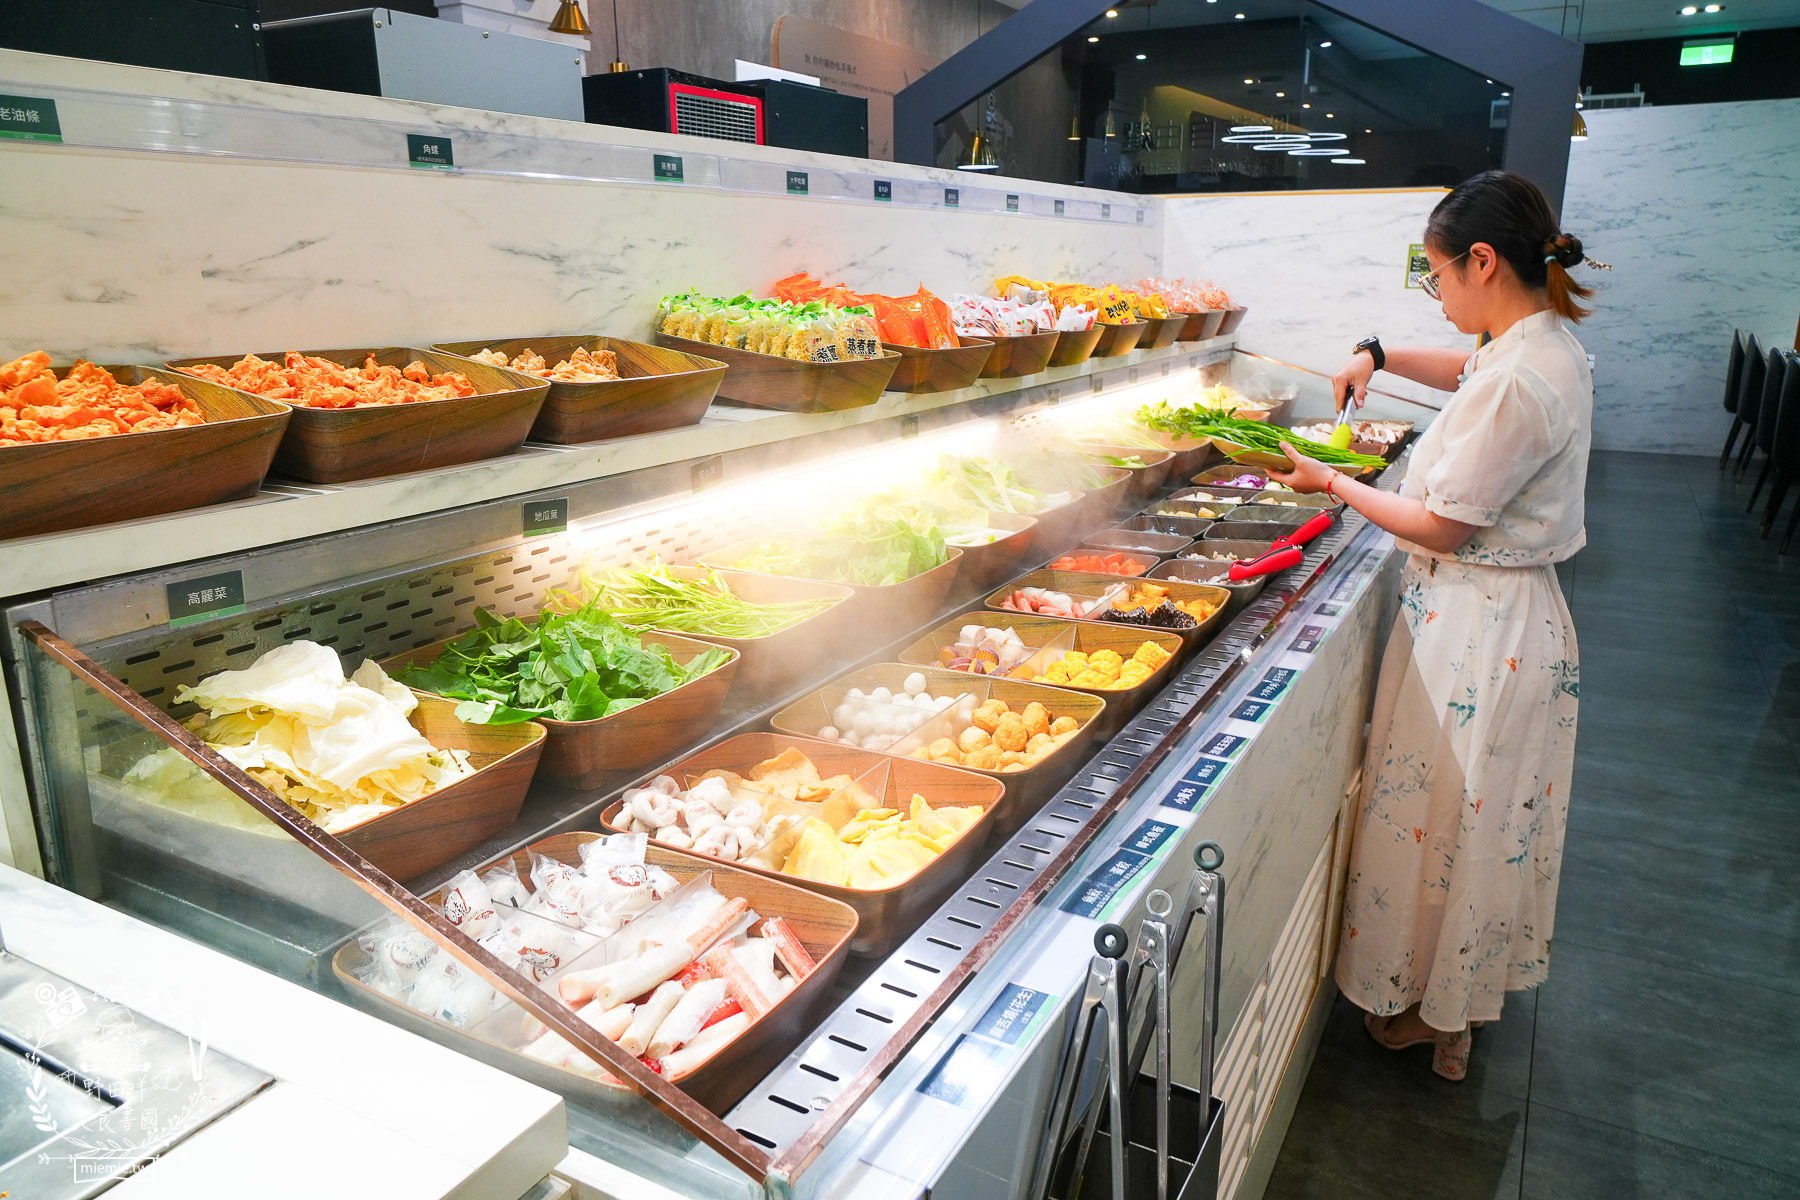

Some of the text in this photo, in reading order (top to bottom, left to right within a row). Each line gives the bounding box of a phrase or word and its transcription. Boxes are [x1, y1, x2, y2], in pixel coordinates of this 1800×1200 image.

[422, 144, 440, 155] 角螺
[846, 337, 877, 355] 蒸煮麵
[534, 509, 558, 522] 地瓜葉
[187, 586, 227, 606] 高麗菜
